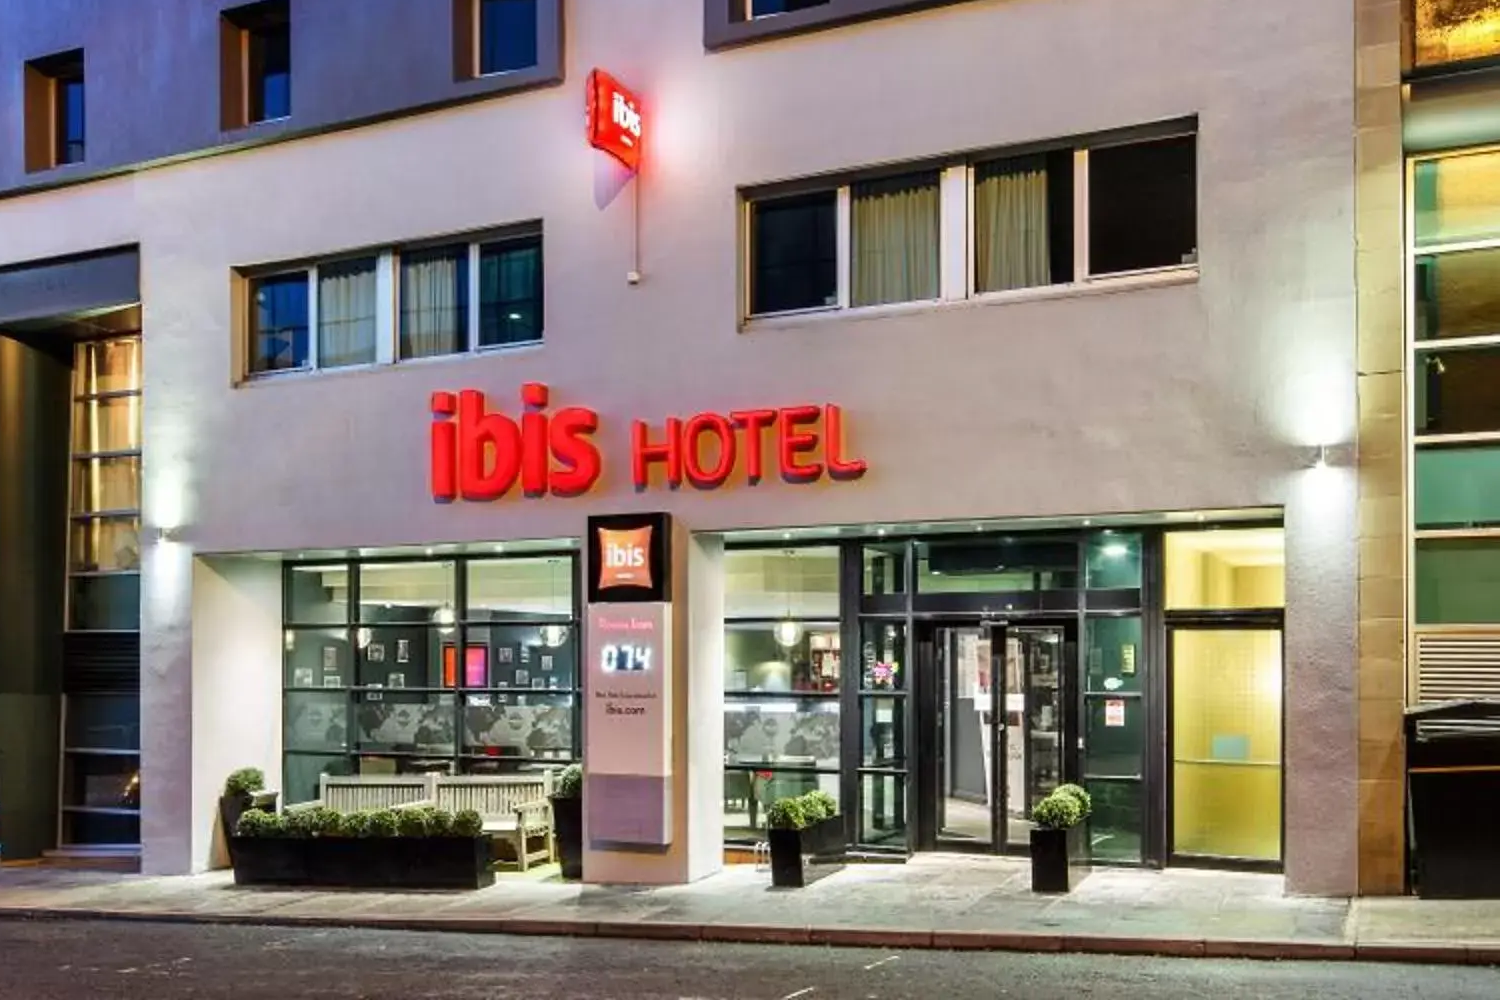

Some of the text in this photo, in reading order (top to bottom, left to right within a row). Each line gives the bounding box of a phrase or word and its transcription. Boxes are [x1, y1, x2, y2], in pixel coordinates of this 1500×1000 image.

[612, 91, 642, 137] ibis
[431, 382, 868, 503] ibis HOTEL
[605, 542, 645, 568] ibis
